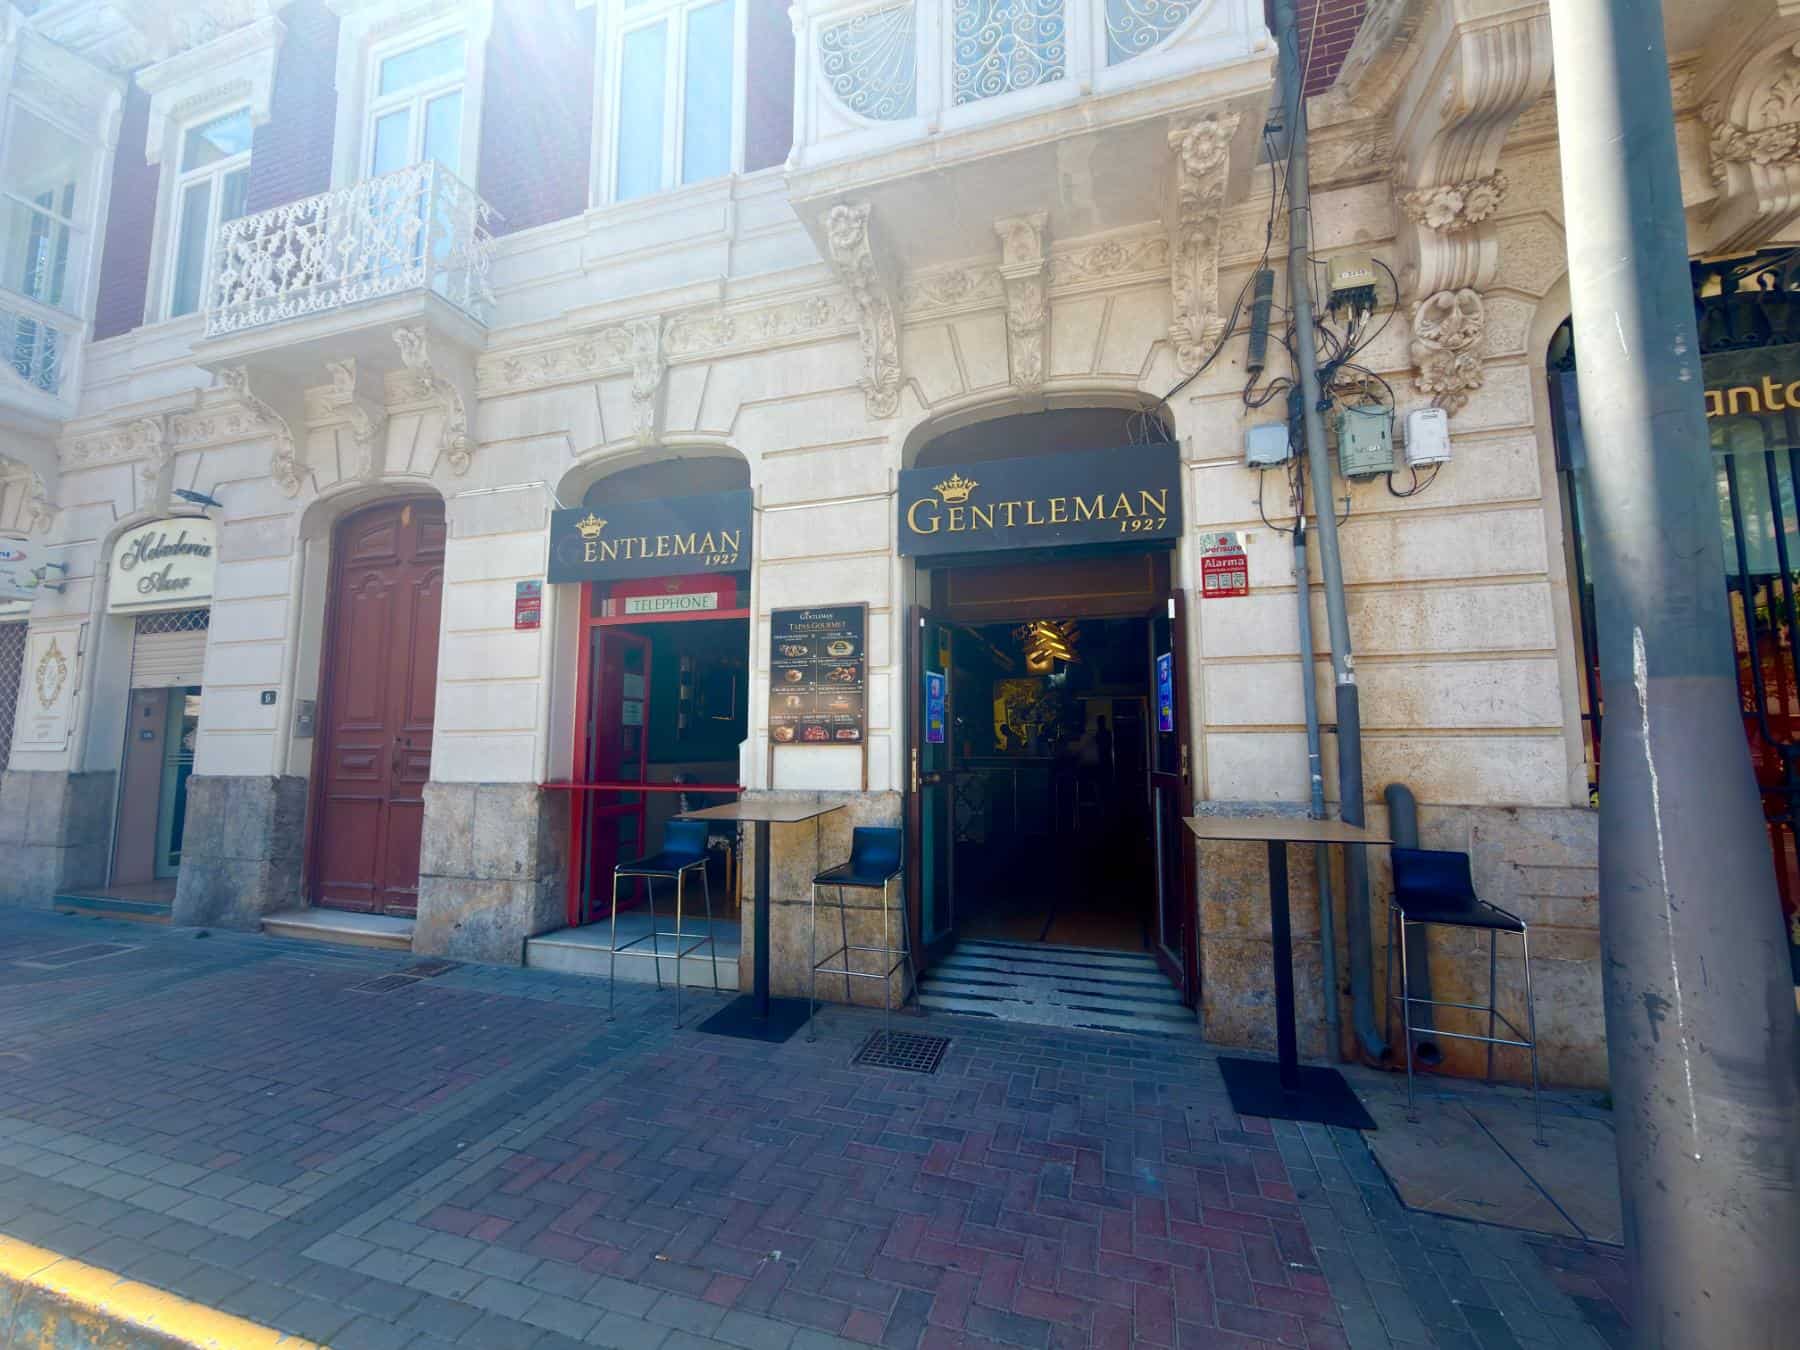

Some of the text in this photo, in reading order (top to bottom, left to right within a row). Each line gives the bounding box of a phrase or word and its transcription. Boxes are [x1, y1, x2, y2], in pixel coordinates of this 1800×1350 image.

[907, 488, 1169, 535] GENTLEMAN
[1119, 517, 1168, 532] 1927
[704, 553, 738, 566] 1927
[1205, 558, 1245, 569] Alarma
[631, 595, 710, 612] TELEPHONE
